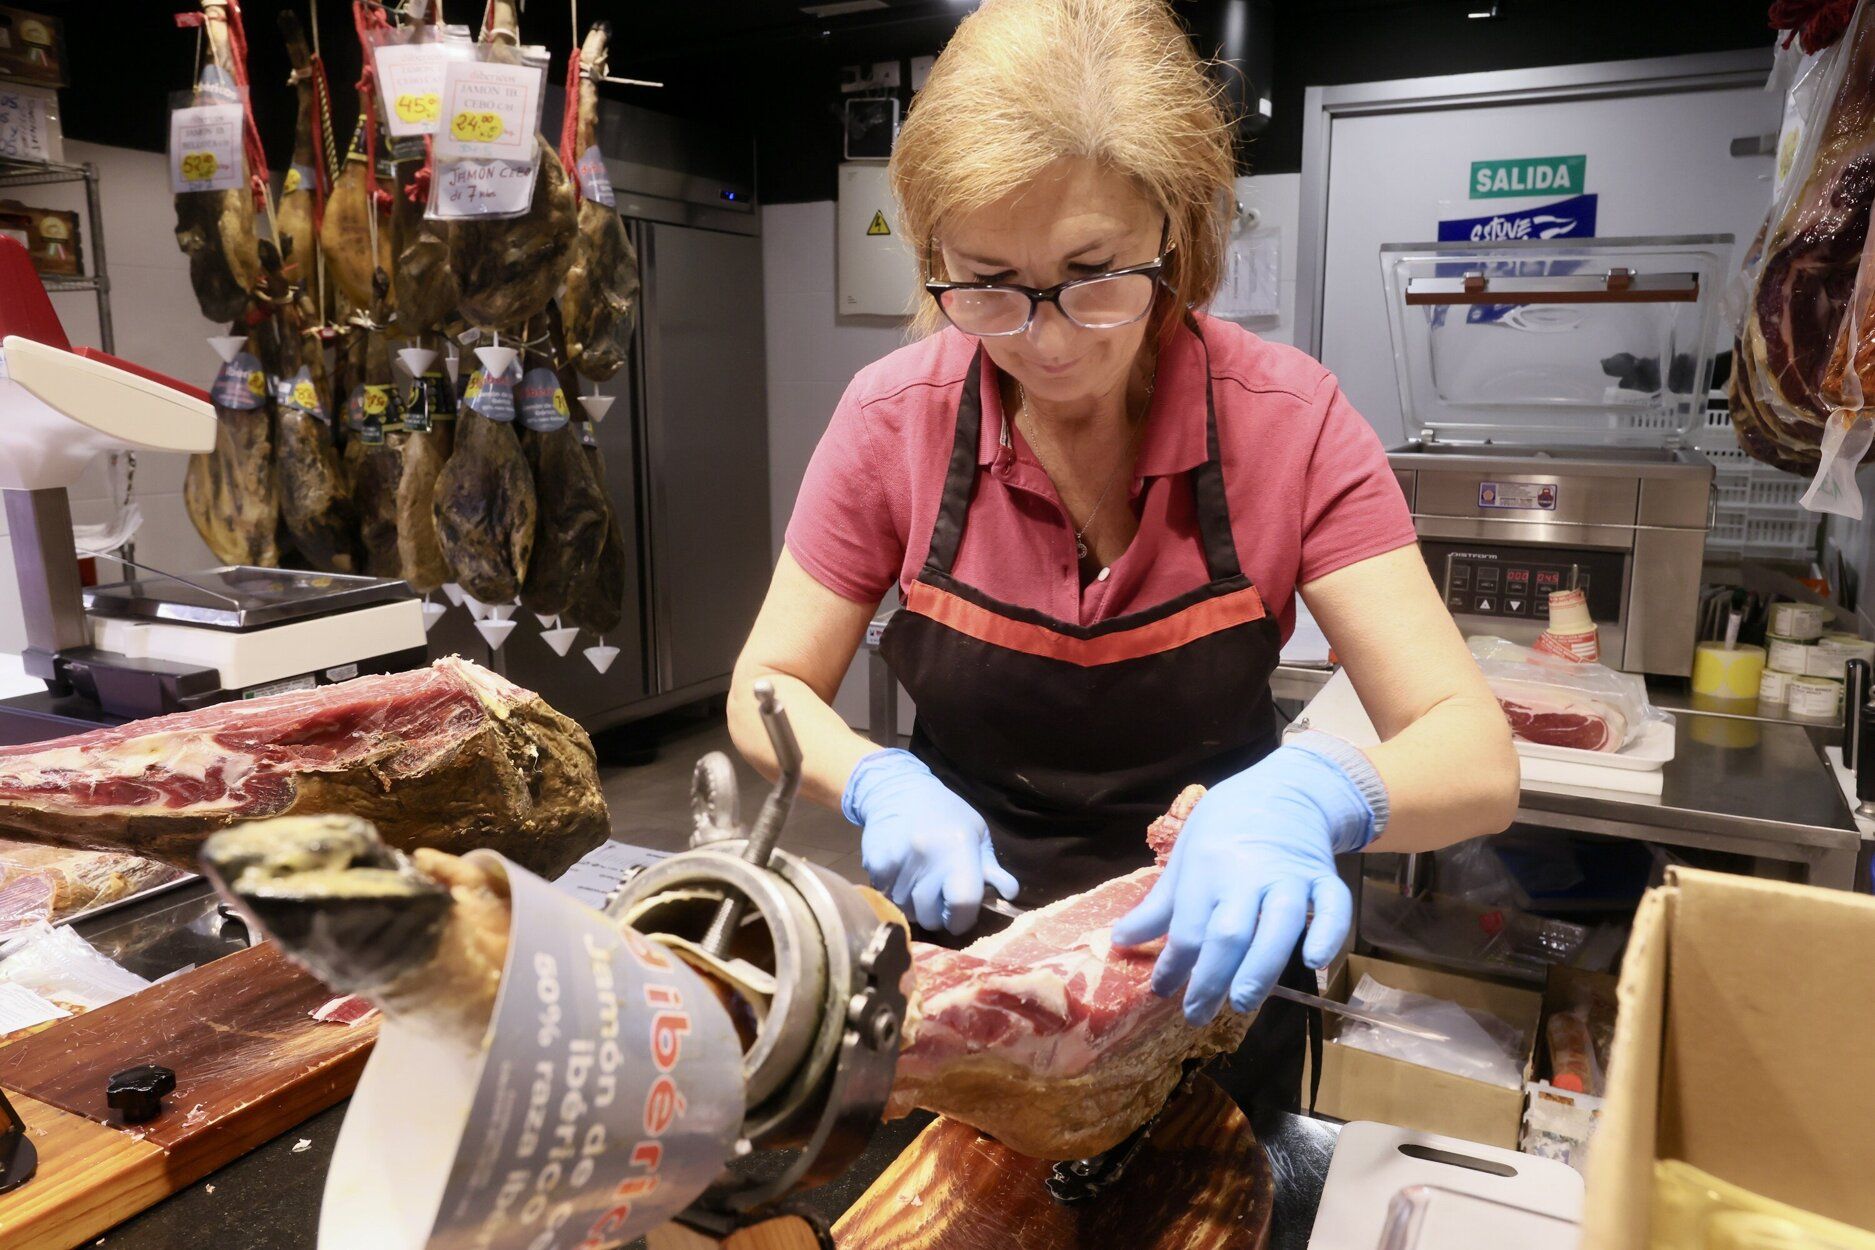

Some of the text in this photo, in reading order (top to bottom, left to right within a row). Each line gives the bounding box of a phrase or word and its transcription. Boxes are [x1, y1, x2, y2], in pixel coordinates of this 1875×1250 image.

[1476, 164, 1571, 192] SALIDA
[467, 185, 477, 202] 7
[1506, 571, 1529, 580] 000
